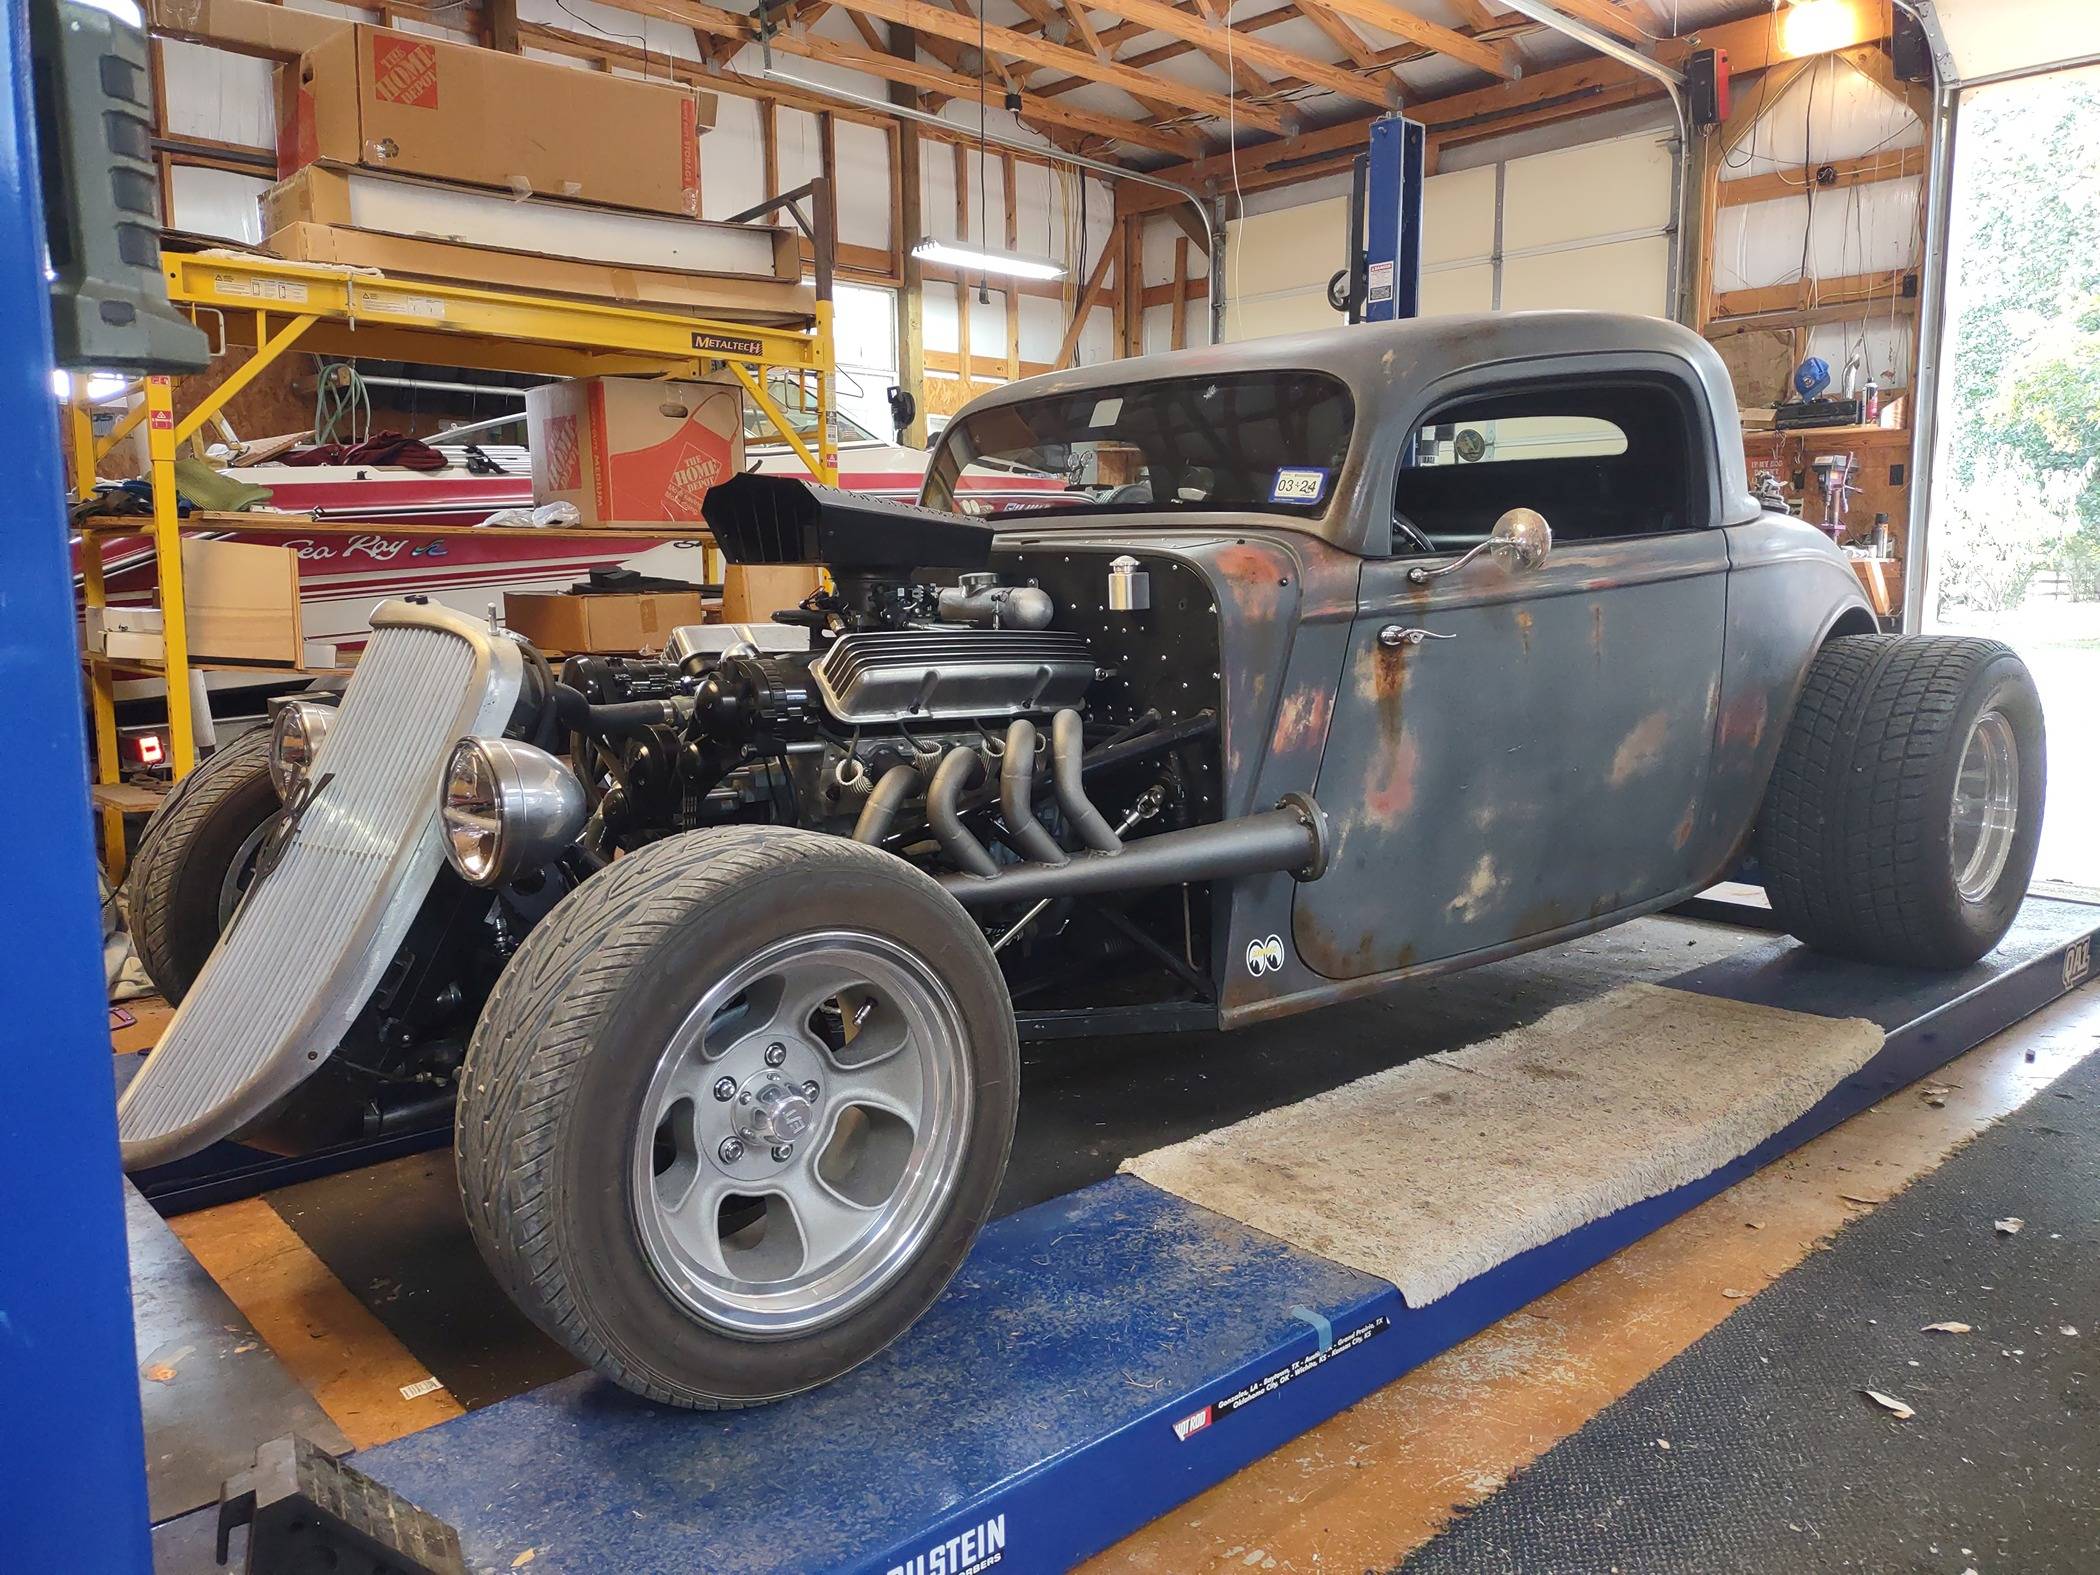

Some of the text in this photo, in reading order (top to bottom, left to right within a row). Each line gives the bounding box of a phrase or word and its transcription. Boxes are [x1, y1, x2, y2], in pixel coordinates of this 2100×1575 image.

[381, 46, 407, 70] THE
[376, 44, 435, 102] HOME
[400, 69, 437, 105] DEPOT
[695, 335, 761, 354] METALTECH
[674, 458, 719, 486] HOME
[684, 454, 703, 467] THE
[686, 476, 715, 493] DEPOT
[342, 533, 409, 561] Ray
[1249, 1382, 1260, 1392] LA
[1291, 1361, 1300, 1371] TX
[1337, 1331, 1356, 1346] Grand
[1376, 1316, 1384, 1326] TX
[1232, 1387, 1266, 1409] Oklahoma
[1279, 1373, 1291, 1385] OK
[1331, 1342, 1352, 1357] Kansas
[1189, 1411, 1206, 1433] ROD
[887, 1513, 1005, 1575] STEIN
